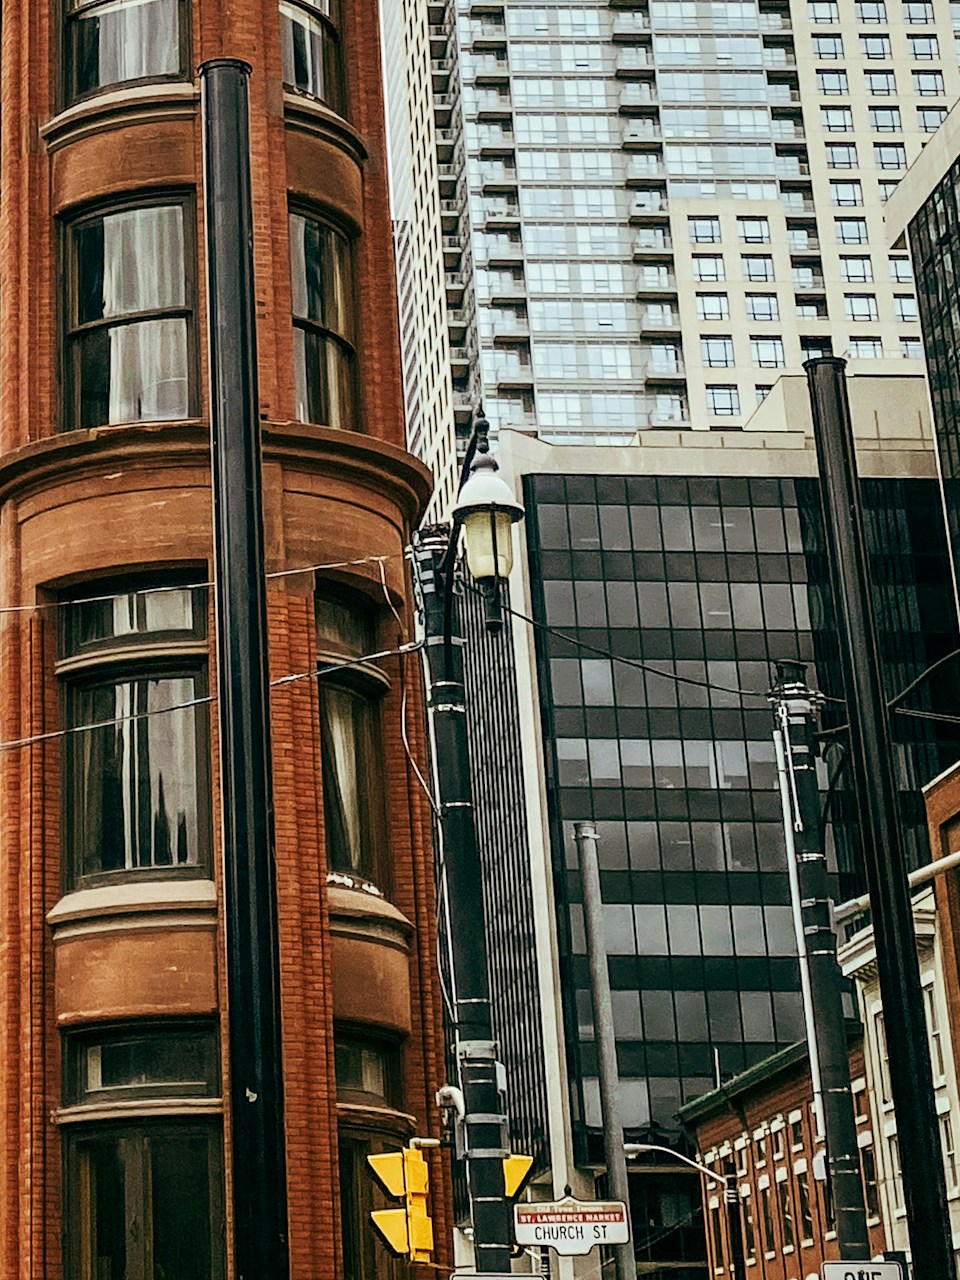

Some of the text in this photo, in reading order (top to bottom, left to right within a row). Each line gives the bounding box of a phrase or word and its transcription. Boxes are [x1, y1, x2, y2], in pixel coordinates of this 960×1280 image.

[520, 1213, 620, 1223] ST. LAWRENCE MARKET
[535, 1225, 607, 1240] CHURCH ST
